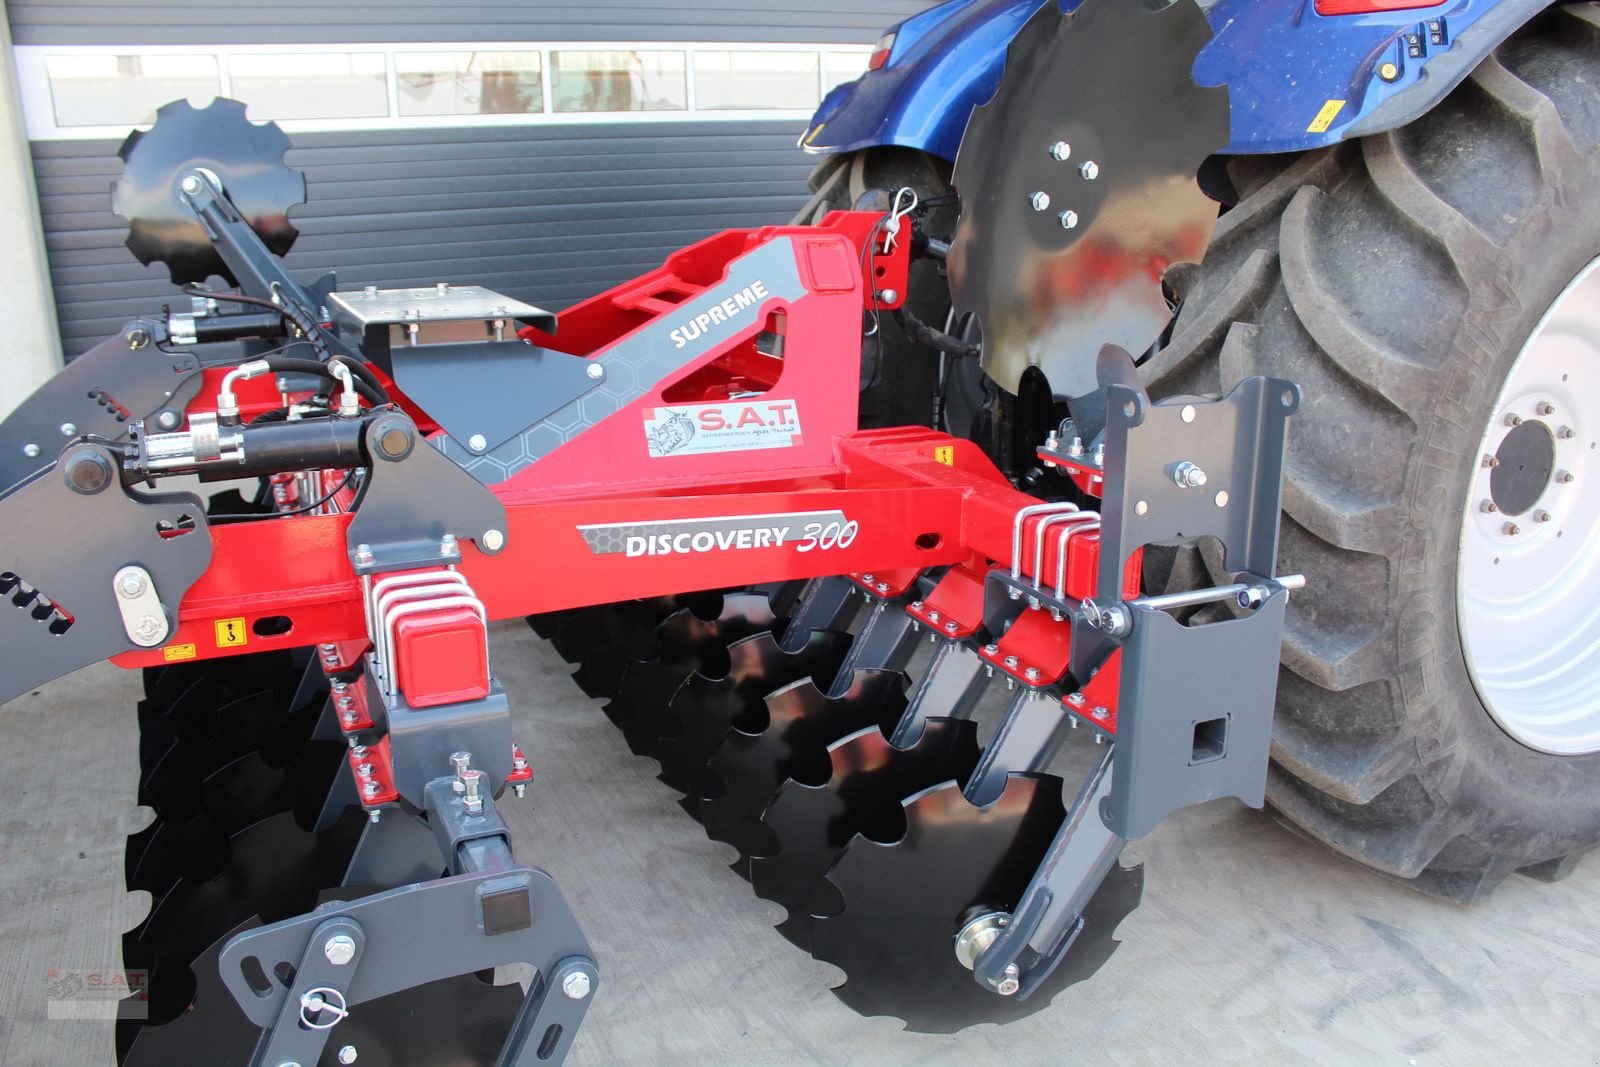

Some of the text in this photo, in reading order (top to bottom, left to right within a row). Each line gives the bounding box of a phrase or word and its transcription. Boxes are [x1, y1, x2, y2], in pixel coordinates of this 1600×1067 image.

[669, 280, 769, 349] SUPREME
[698, 404, 795, 431] S.A.T.
[625, 520, 859, 558] DISCOVERY 300
